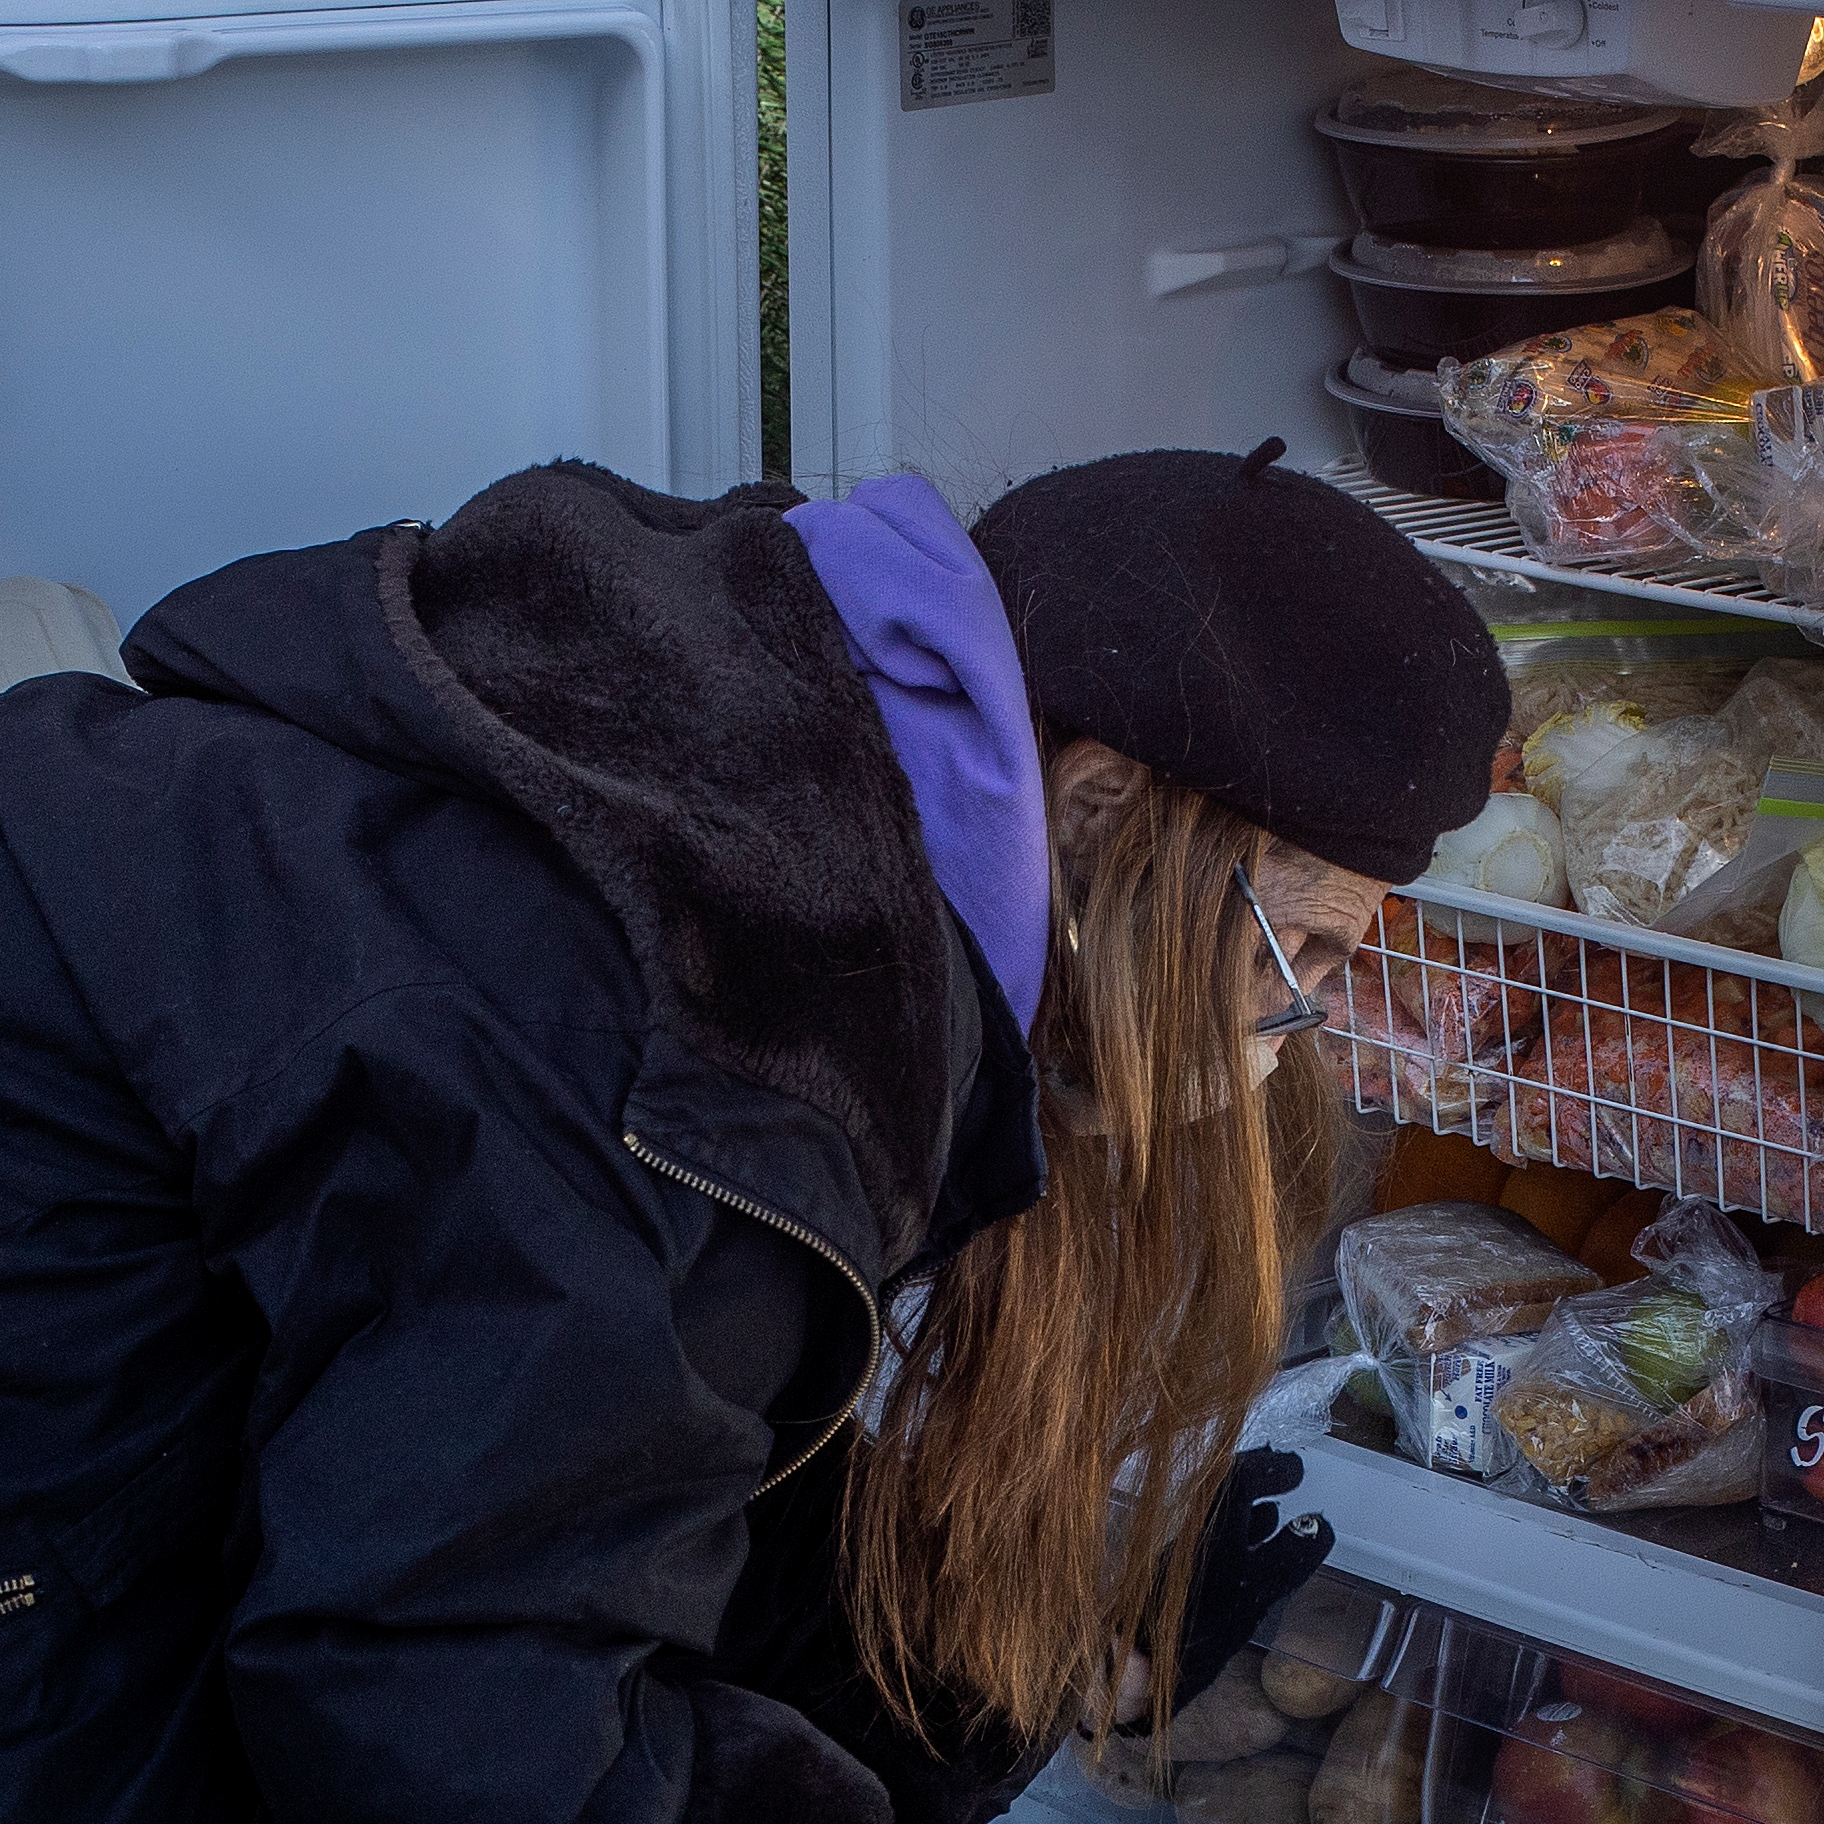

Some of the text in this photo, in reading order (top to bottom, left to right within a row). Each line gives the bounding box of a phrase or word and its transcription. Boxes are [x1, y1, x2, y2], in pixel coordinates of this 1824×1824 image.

[1593, 2, 1619, 12] Coldest
[1481, 28, 1520, 40] Temperatu
[1595, 40, 1607, 48] Off
[1483, 1361, 1496, 1384] MILK
[1475, 1360, 1484, 1402] FAT FREE
